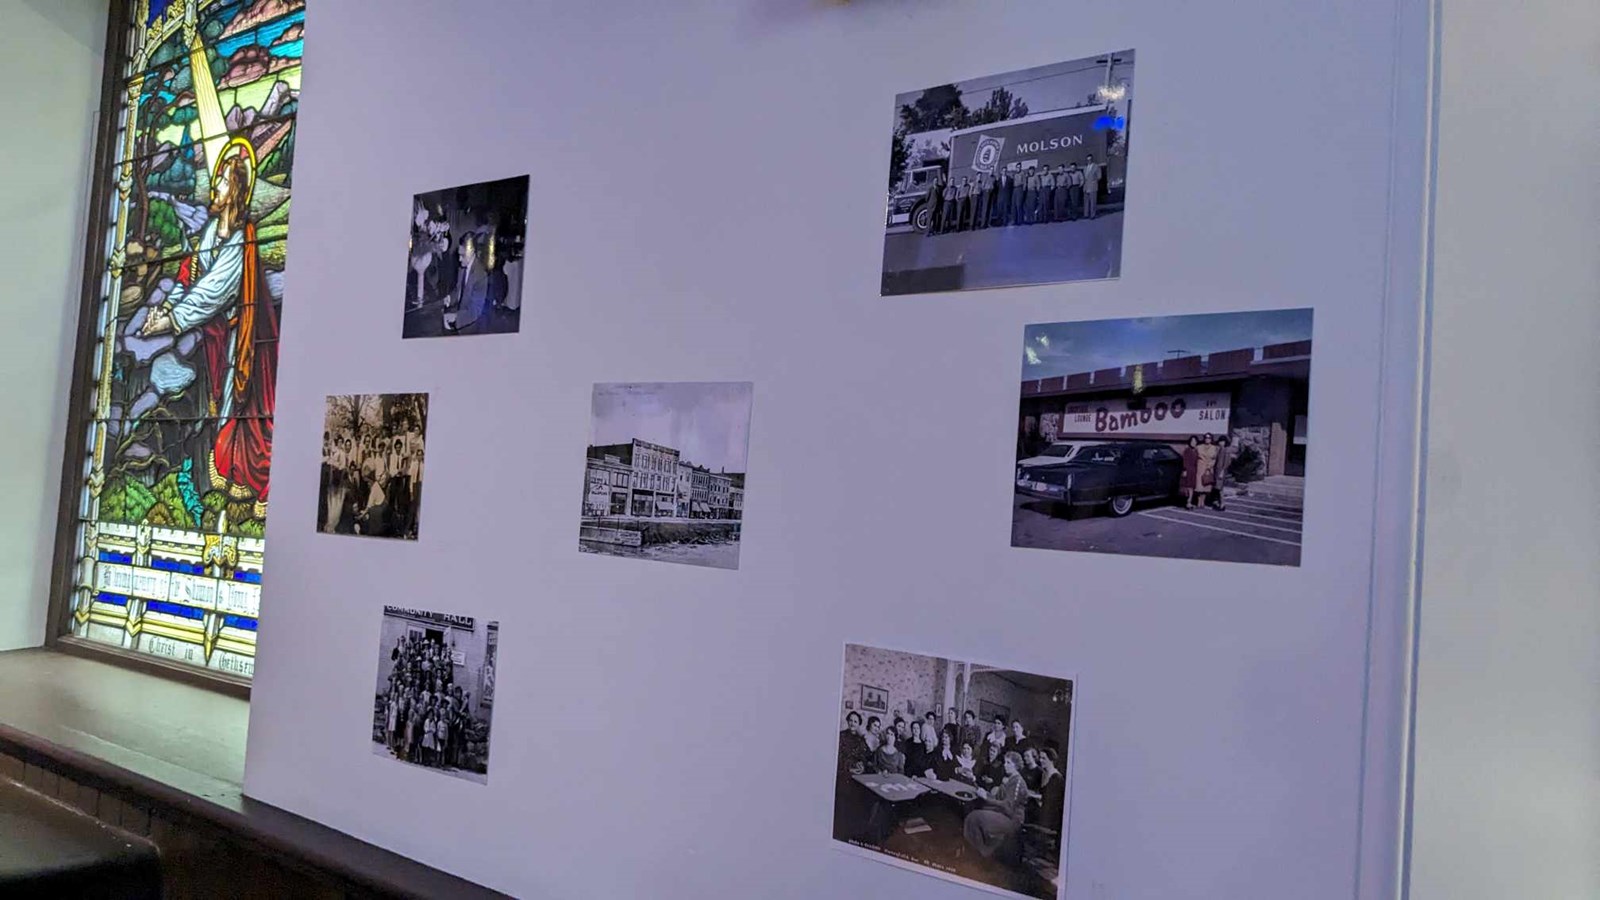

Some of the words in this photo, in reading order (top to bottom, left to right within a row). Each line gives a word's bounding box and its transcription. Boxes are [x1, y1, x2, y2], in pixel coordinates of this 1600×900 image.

[1016, 134, 1083, 155] MOLSON
[1094, 397, 1187, 433] Bamboo
[1199, 409, 1226, 421] SALON
[443, 613, 472, 625] HALL
[148, 636, 176, 656] Christ
[184, 646, 195, 661] in
